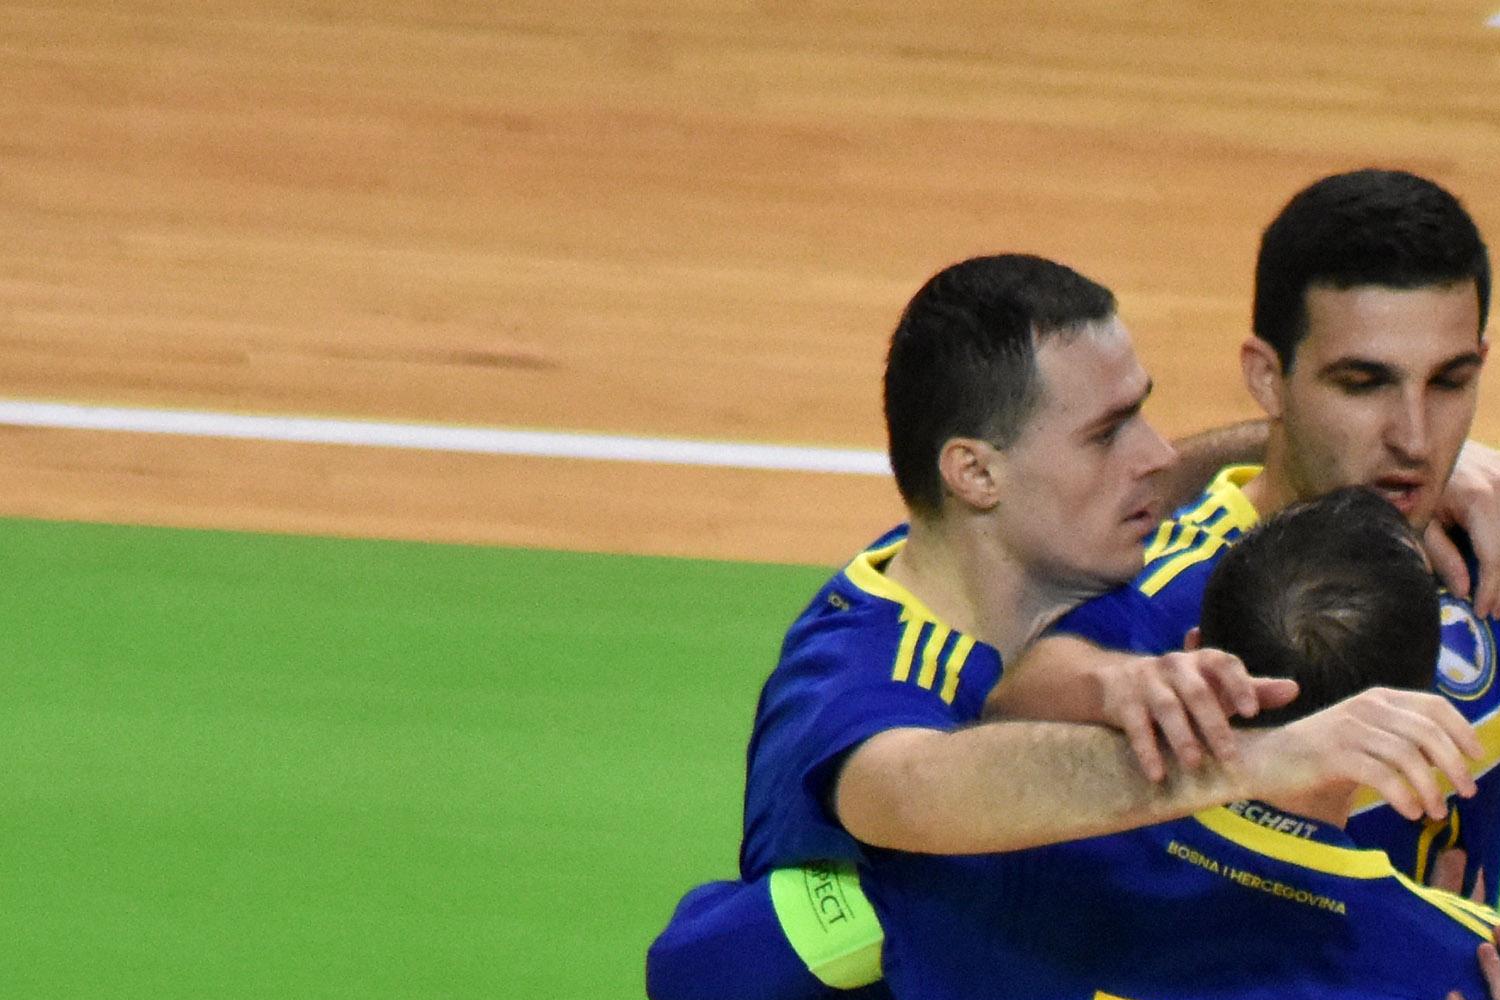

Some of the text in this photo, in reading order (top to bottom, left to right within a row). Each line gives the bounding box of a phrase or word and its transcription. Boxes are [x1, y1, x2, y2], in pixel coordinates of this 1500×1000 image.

[811, 867, 848, 924] PECT
[1166, 839, 1347, 915] BOSNA I HERCEGOVINA
